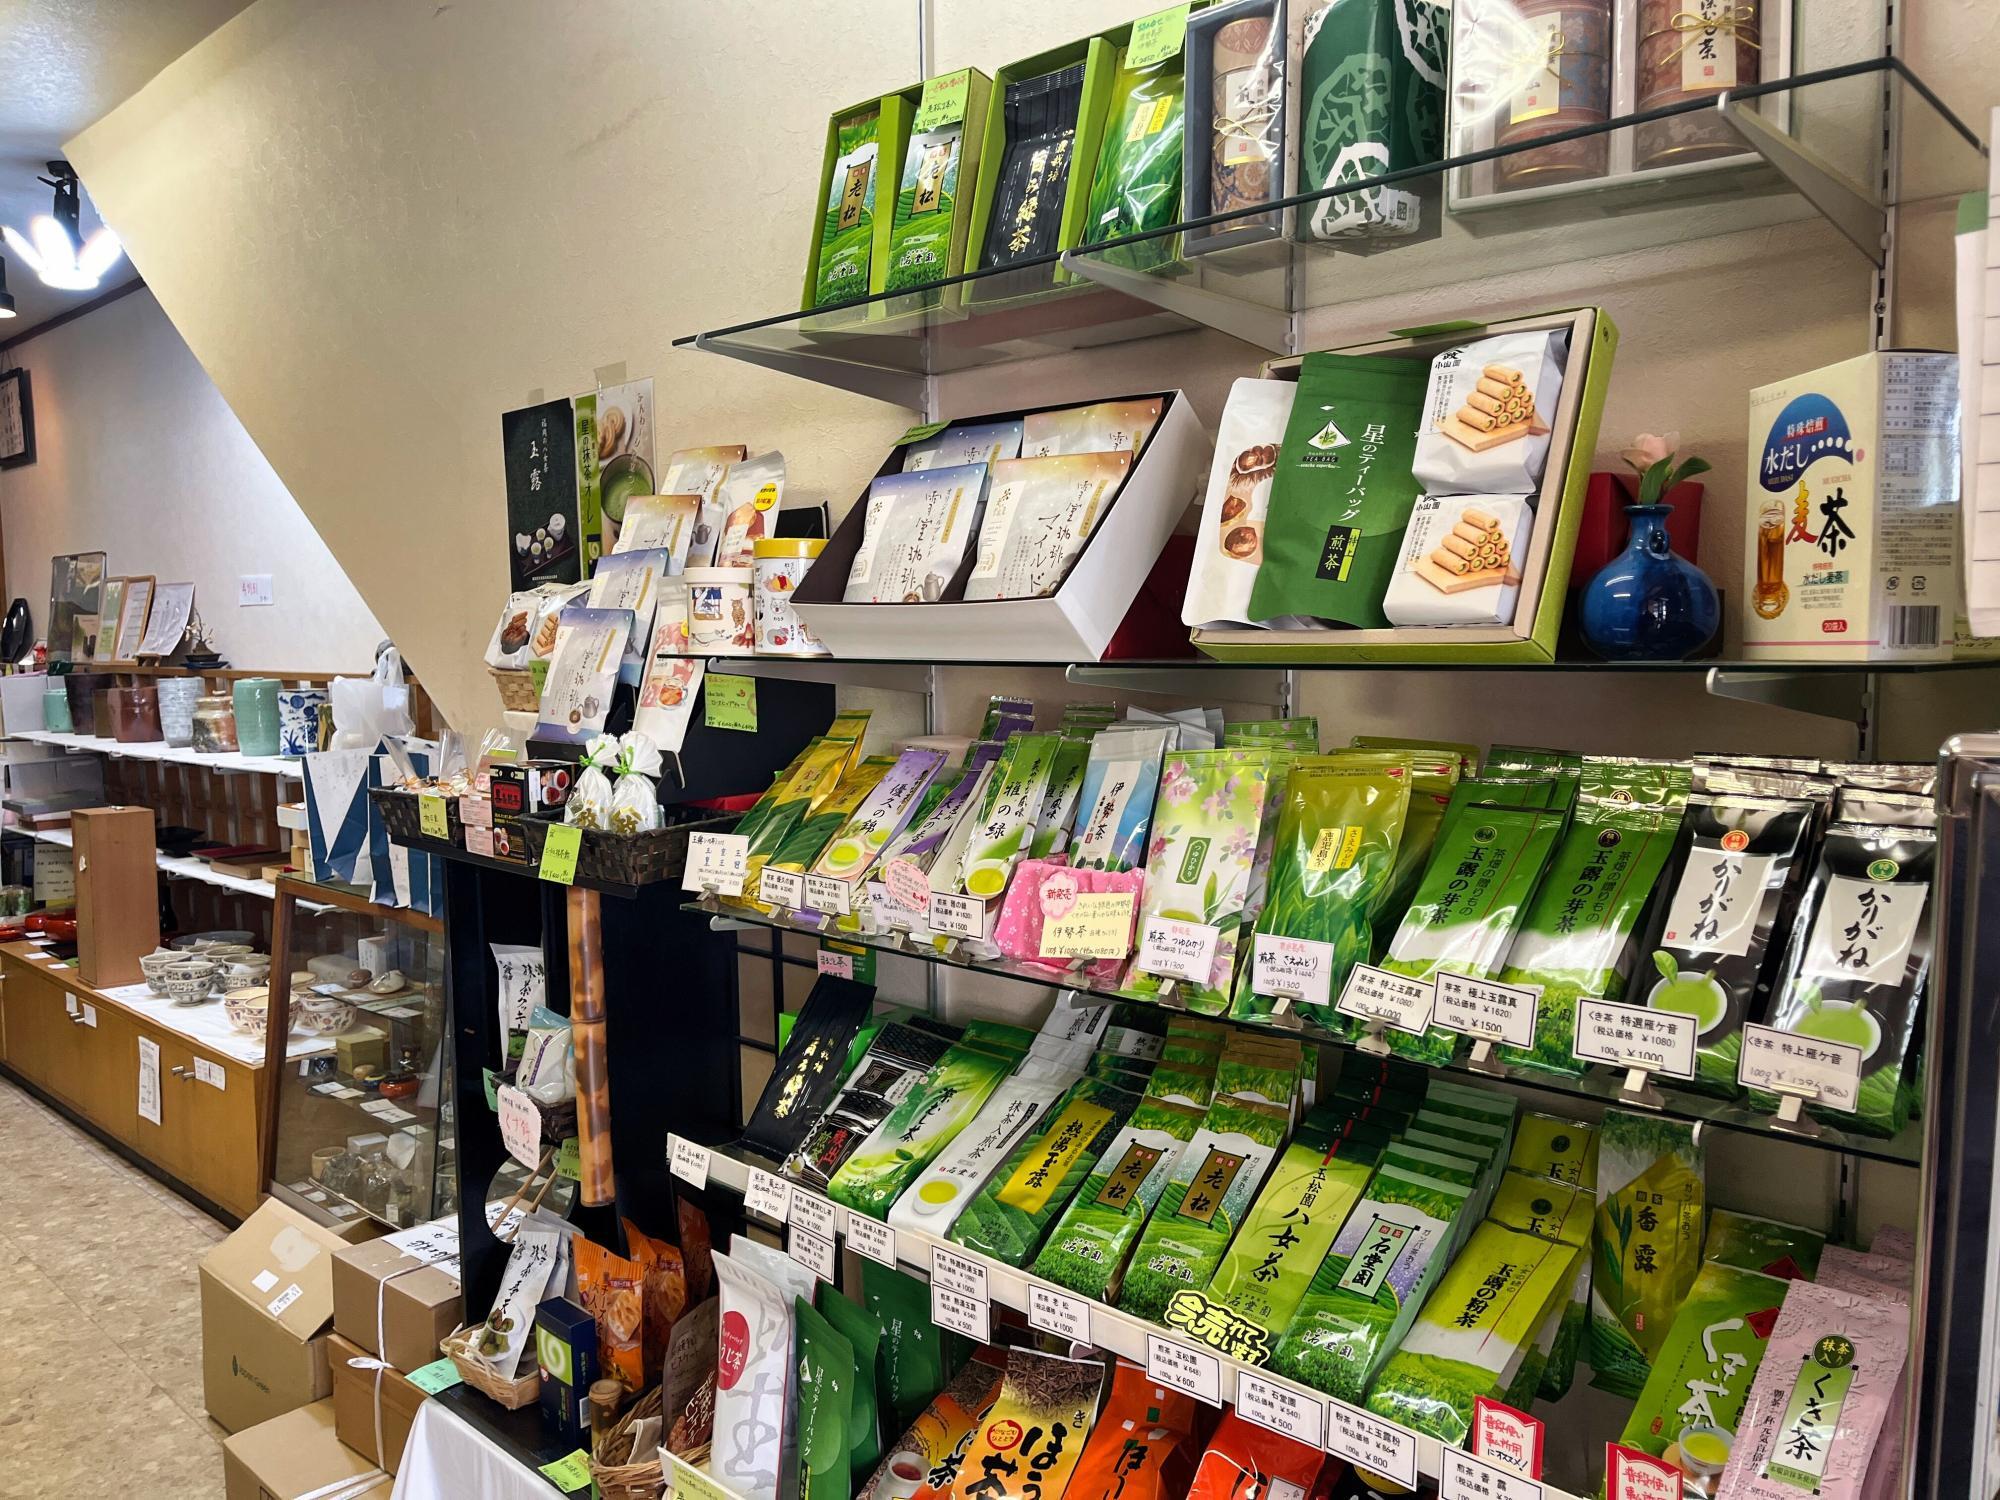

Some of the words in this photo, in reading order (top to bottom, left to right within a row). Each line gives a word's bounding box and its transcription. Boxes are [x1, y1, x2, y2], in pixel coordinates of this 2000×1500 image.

[918, 159, 940, 206] 老松
[843, 179, 863, 223] 老松
[1435, 359, 1462, 369] 小山園
[529, 440, 543, 491] 玉露
[581, 419, 595, 524] 星の抹茶オーレ
[1338, 423, 1386, 521] 星のティーバッグ
[1764, 444, 1809, 475] 水だし
[1416, 501, 1441, 511] 小山園
[1785, 480, 1856, 558] 麦茶
[1030, 513, 1060, 592] マイルド
[1324, 534, 1346, 571] 煎茶
[1803, 571, 1844, 585] 水だし麦茶
[861, 783, 909, 836] 優久の錦
[985, 780, 1021, 839] 雅の緑
[1095, 781, 1126, 841] 伊勢茶
[1187, 844, 1202, 878] つゆひかり
[1340, 829, 1359, 868] さえみどり
[1046, 888, 1072, 900] 新発売
[1430, 846, 1486, 925] 玉露の芽茶
[1458, 848, 1506, 917] 茶畑の贈りもの
[1554, 848, 1614, 934] 玉露の芽茶
[1585, 850, 1632, 923] 茶畑の贈りもの
[1690, 859, 1742, 941] かりがね
[1148, 930, 1166, 943] 煎茶
[1172, 937, 1206, 950] つゆひかり
[1835, 887, 1892, 969] かりがね
[1164, 959, 1185, 970] ¥1300
[1259, 952, 1276, 963] 煎茶
[1283, 956, 1318, 970] さえみどり
[1277, 979, 1301, 989] ¥1300
[1359, 974, 1374, 985] 芽茶
[1444, 983, 1461, 993] 芽茶
[1354, 985, 1384, 999] (税込価格
[1389, 995, 1415, 1008] ¥1080)
[1442, 996, 1477, 1010] (税込価格
[1483, 1005, 1512, 1019] ¥1620)
[1449, 1015, 1465, 1026] 100g
[1471, 1018, 1502, 1033] ¥1500
[1588, 1012, 1614, 1023] くき茶
[1593, 1026, 1634, 1041] (税込価格
[1642, 1035, 1676, 1048] ¥1080)
[1747, 1036, 1774, 1051] くき茶
[1600, 1045, 1620, 1057] 100g
[1626, 1048, 1664, 1063] ¥1000
[968, 1100, 1022, 1160] 抹茶入煎茶
[1025, 1119, 1080, 1189] 熱湯玉露
[945, 1166, 979, 1179] 石堂園
[1106, 1159, 1144, 1200] 老松
[1191, 1169, 1226, 1212] 老松
[1300, 1168, 1328, 1208] 玉松園
[1065, 1241, 1103, 1263] 石堂園
[1251, 1206, 1311, 1283] 八女茶
[1634, 1206, 1660, 1274] 香露
[1153, 1258, 1194, 1283] 石堂園
[1352, 1237, 1392, 1288] 石堂園
[957, 1282, 975, 1295] ¥1000
[1037, 1293, 1049, 1303] 煎茶
[1453, 1261, 1517, 1328] 玉露の粉茶
[1172, 1293, 1260, 1345] 今売れて
[1227, 1293, 1272, 1318] 石堂園
[1053, 1320, 1074, 1334] ¥1000
[1157, 1344, 1171, 1355] 煎茶
[1175, 1350, 1198, 1366] 玉松園
[1221, 1337, 1263, 1365] います
[1306, 1331, 1353, 1359] 石堂園
[1821, 1352, 1844, 1366] 入り
[1822, 1338, 1851, 1355] 抹茶
[889, 1318, 904, 1402] 星のティーバッグ
[1676, 1317, 1749, 1430] くき茶
[1176, 1374, 1195, 1389] ¥600
[1250, 1382, 1266, 1393] 煎茶
[1271, 1389, 1297, 1408] 石堂園
[803, 1365, 825, 1456] 星のティーバッグ
[1244, 1392, 1275, 1409] (税込価格
[1279, 1405, 1301, 1420] ¥540)
[1270, 1415, 1293, 1431] ¥500
[1335, 1411, 1351, 1424] 粉茶
[1357, 1419, 1401, 1447] 特上玉露粉
[1339, 1426, 1370, 1444] (税込価格
[1482, 1413, 1526, 1440] 普段使い
[1365, 1451, 1388, 1469] ¥800
[1456, 1463, 1475, 1478] 煎茶
[1486, 1447, 1529, 1471] にオススメ!
[1455, 1475, 1490, 1497] (税込価格
[1622, 1465, 1675, 1494] 普段使い
